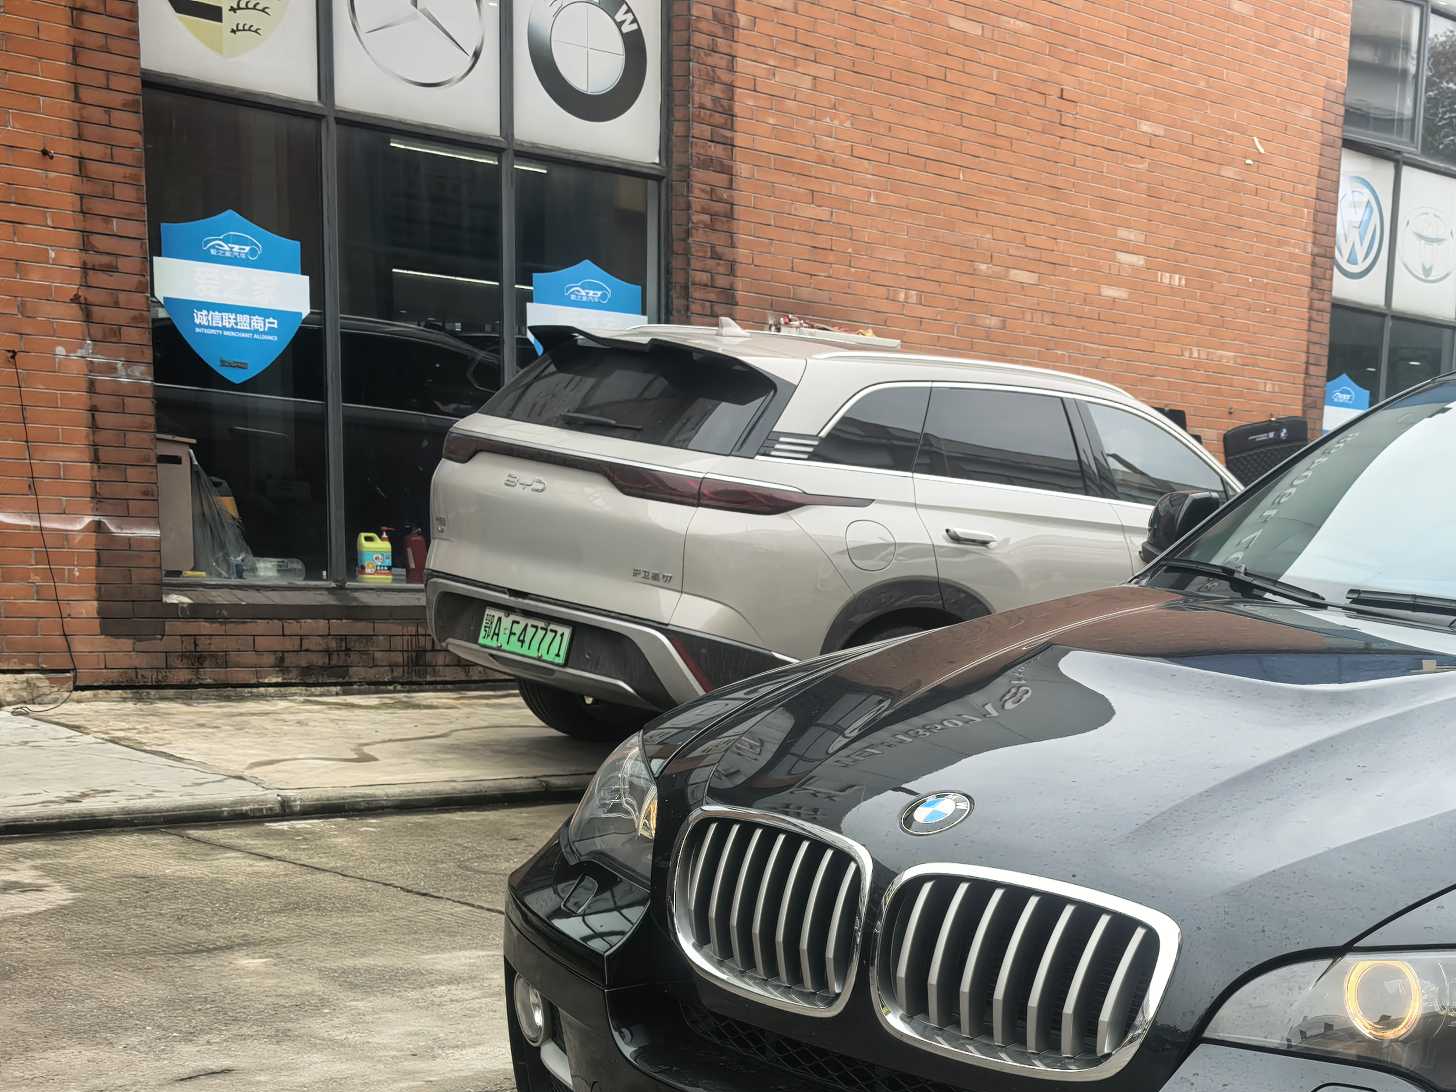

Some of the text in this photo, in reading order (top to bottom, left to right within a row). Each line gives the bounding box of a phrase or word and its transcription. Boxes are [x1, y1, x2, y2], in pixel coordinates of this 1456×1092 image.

[193, 309, 278, 332] 诚信联盟商户
